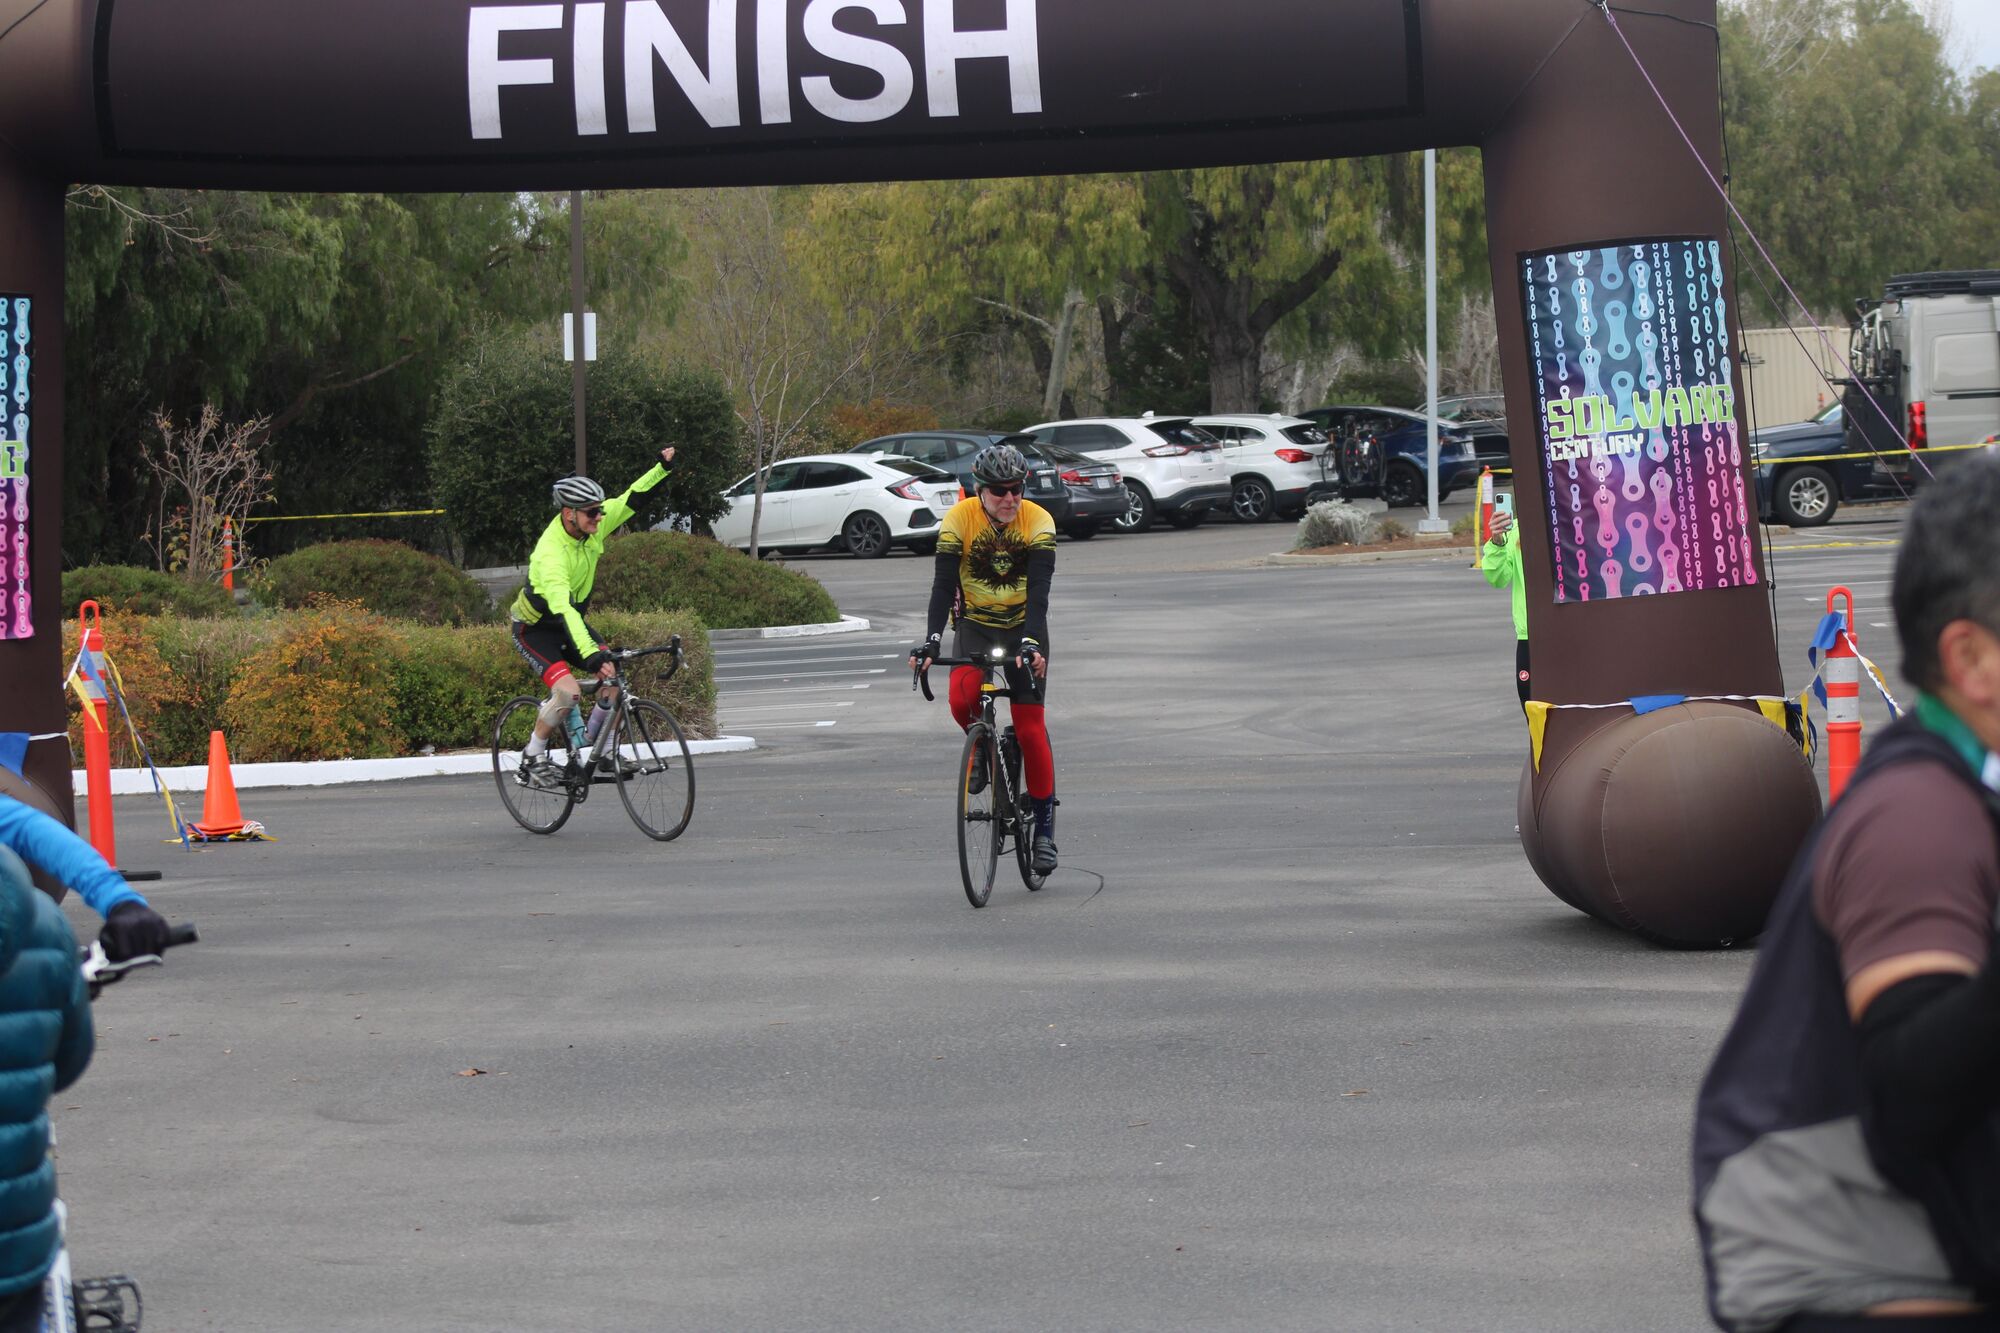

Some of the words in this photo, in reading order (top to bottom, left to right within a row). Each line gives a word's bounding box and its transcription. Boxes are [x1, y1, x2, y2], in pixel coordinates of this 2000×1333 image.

[468, 0, 1043, 139] FINISH
[1547, 384, 1735, 438] SOLVANG
[1550, 433, 1644, 462] CENTURY
